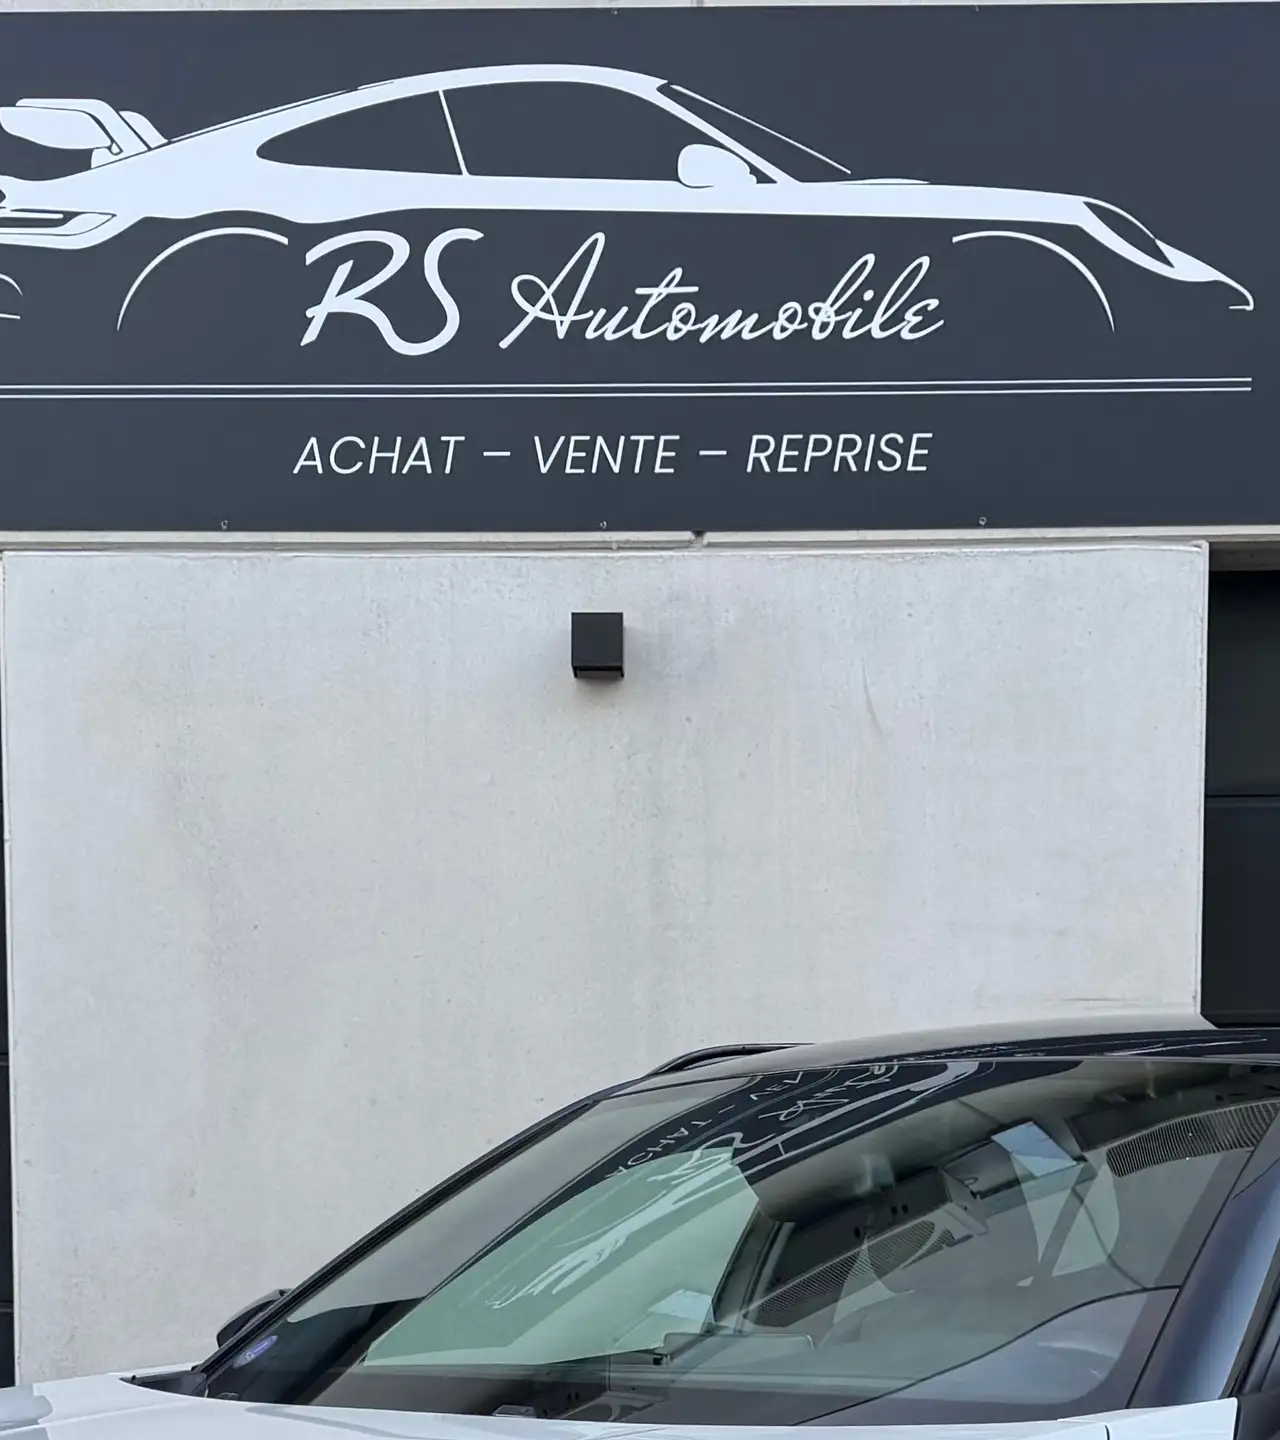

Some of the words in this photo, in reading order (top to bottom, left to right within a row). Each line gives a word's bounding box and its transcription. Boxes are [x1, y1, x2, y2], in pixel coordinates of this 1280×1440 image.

[300, 227, 485, 356] RS
[498, 231, 945, 350] Automobile
[292, 435, 466, 475] ACHAT
[533, 434, 681, 474] VENTE
[746, 432, 933, 473] REPRISE
